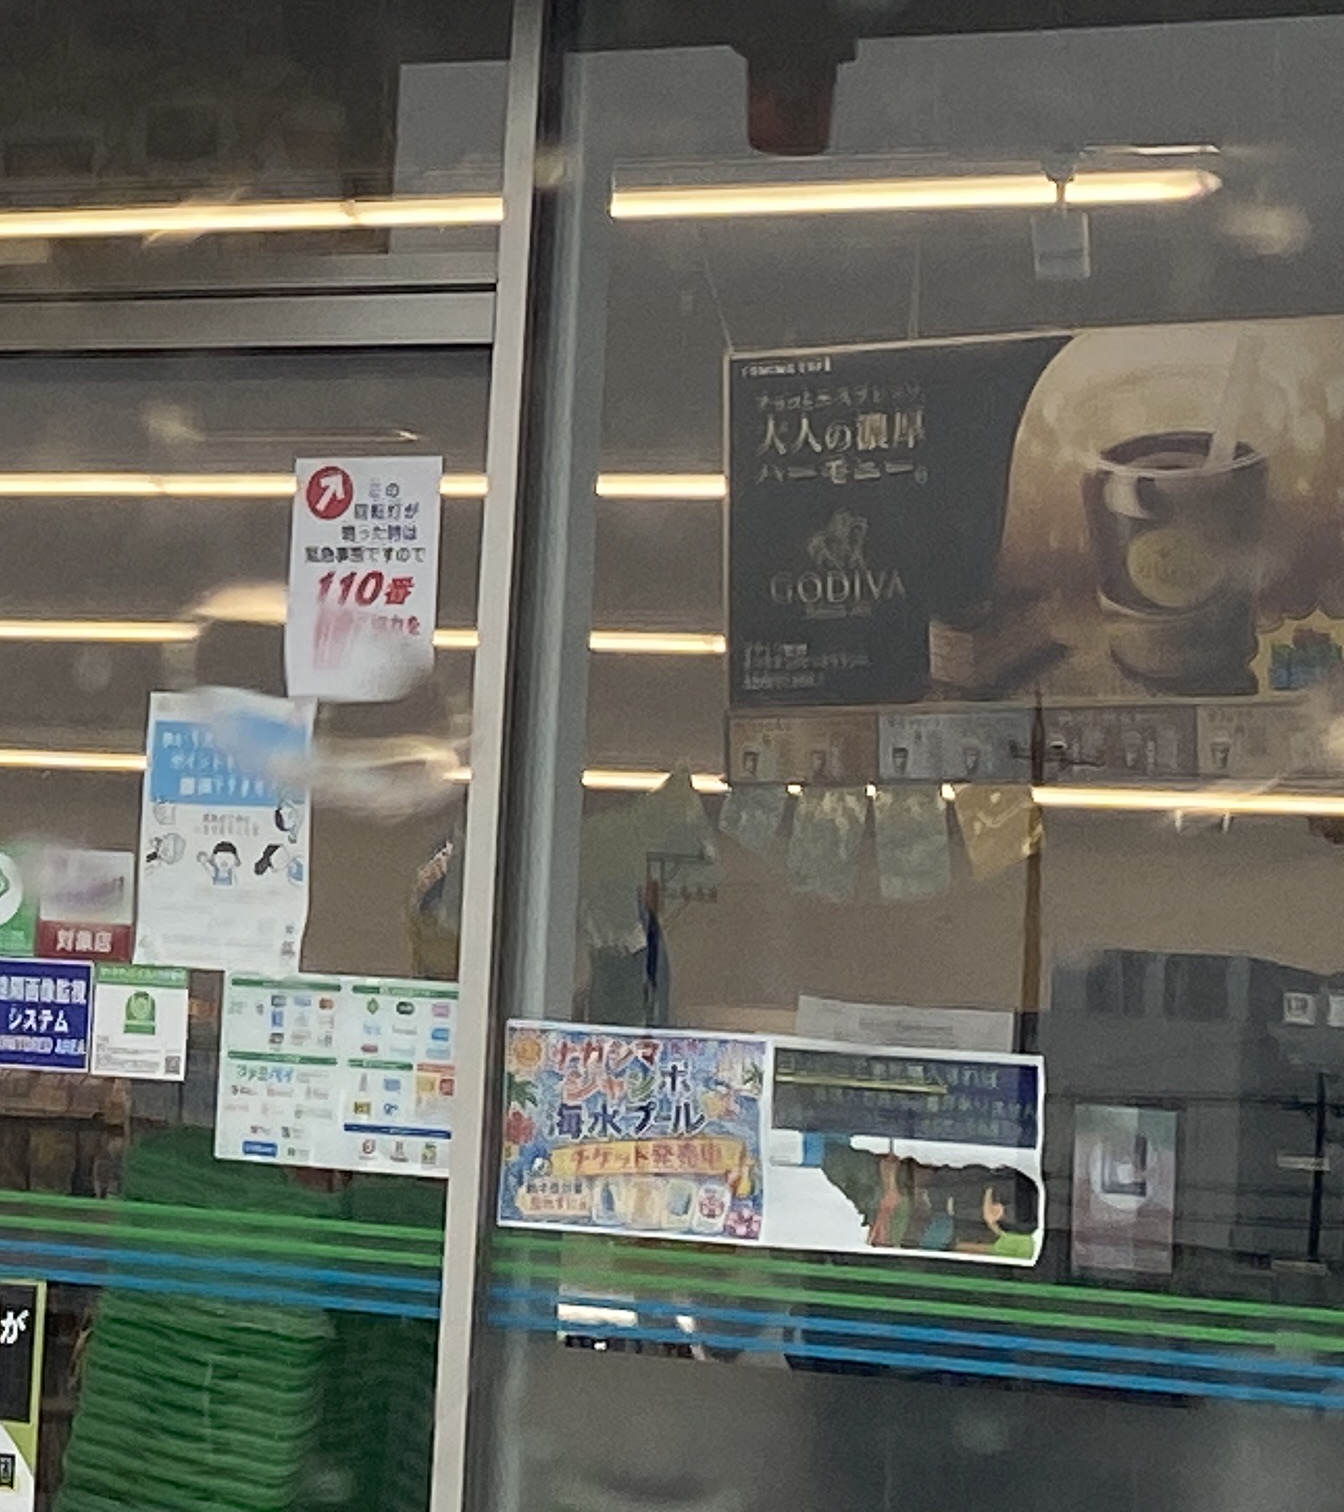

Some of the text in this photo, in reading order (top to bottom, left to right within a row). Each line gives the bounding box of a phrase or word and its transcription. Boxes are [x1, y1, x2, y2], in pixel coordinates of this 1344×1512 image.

[317, 569, 416, 607] 110番
[770, 569, 907, 605] GODIVA
[55, 928, 113, 953] 対象店
[7, 1008, 69, 1033] システム
[552, 1039, 662, 1075] ナガシマ
[548, 1099, 707, 1141] 海水プール
[570, 1140, 724, 1171] チケット発売中
